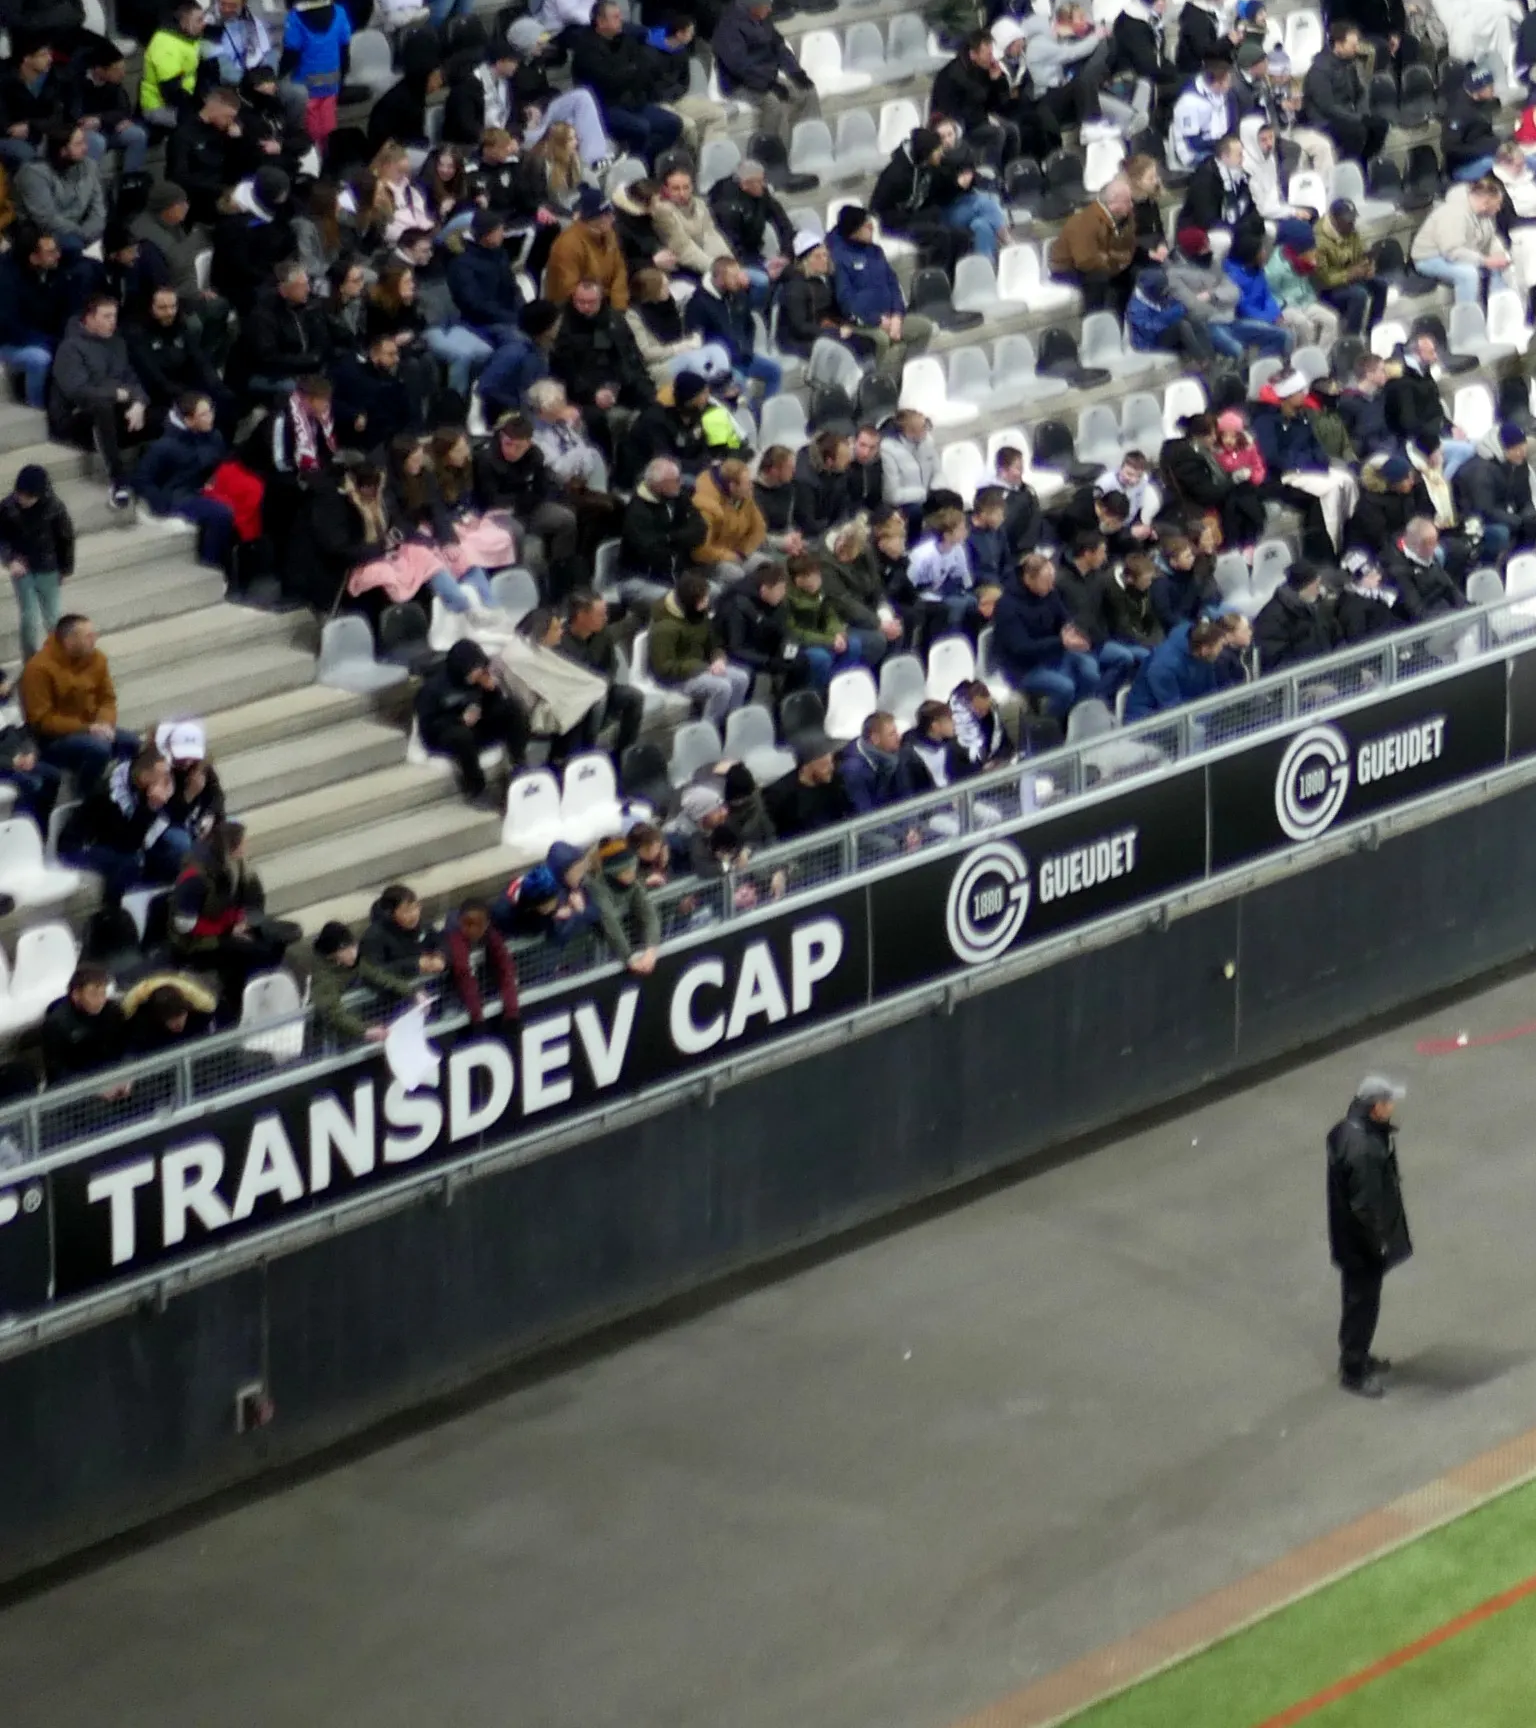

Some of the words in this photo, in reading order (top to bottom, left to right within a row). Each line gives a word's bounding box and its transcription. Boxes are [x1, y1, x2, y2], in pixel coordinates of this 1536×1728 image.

[1357, 715, 1447, 786] GUEUDET
[1039, 827, 1139, 904] GUEUDET
[88, 986, 642, 1266] TRANSDEV
[669, 915, 845, 1056] CAP
